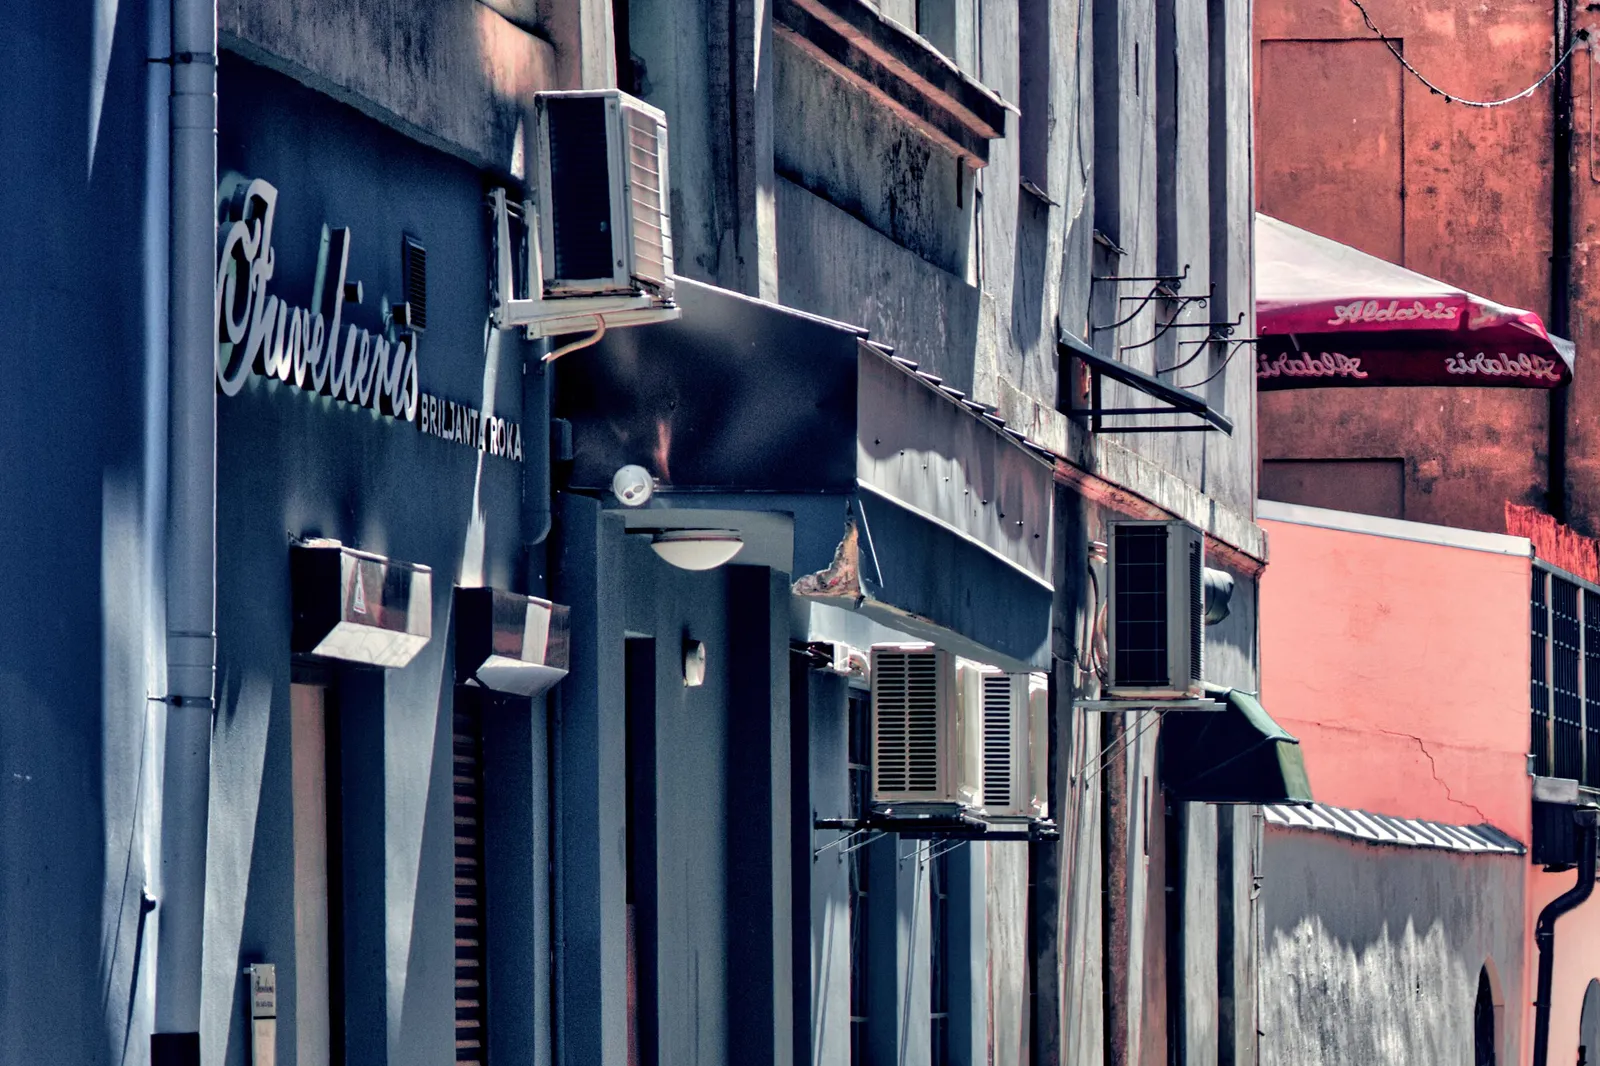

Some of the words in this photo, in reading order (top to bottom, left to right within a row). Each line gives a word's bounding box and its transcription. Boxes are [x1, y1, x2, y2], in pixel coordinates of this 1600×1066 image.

[1327, 300, 1458, 326] Aldaris
[421, 392, 486, 452] BRILJANTA
[490, 415, 522, 462] ROKA
